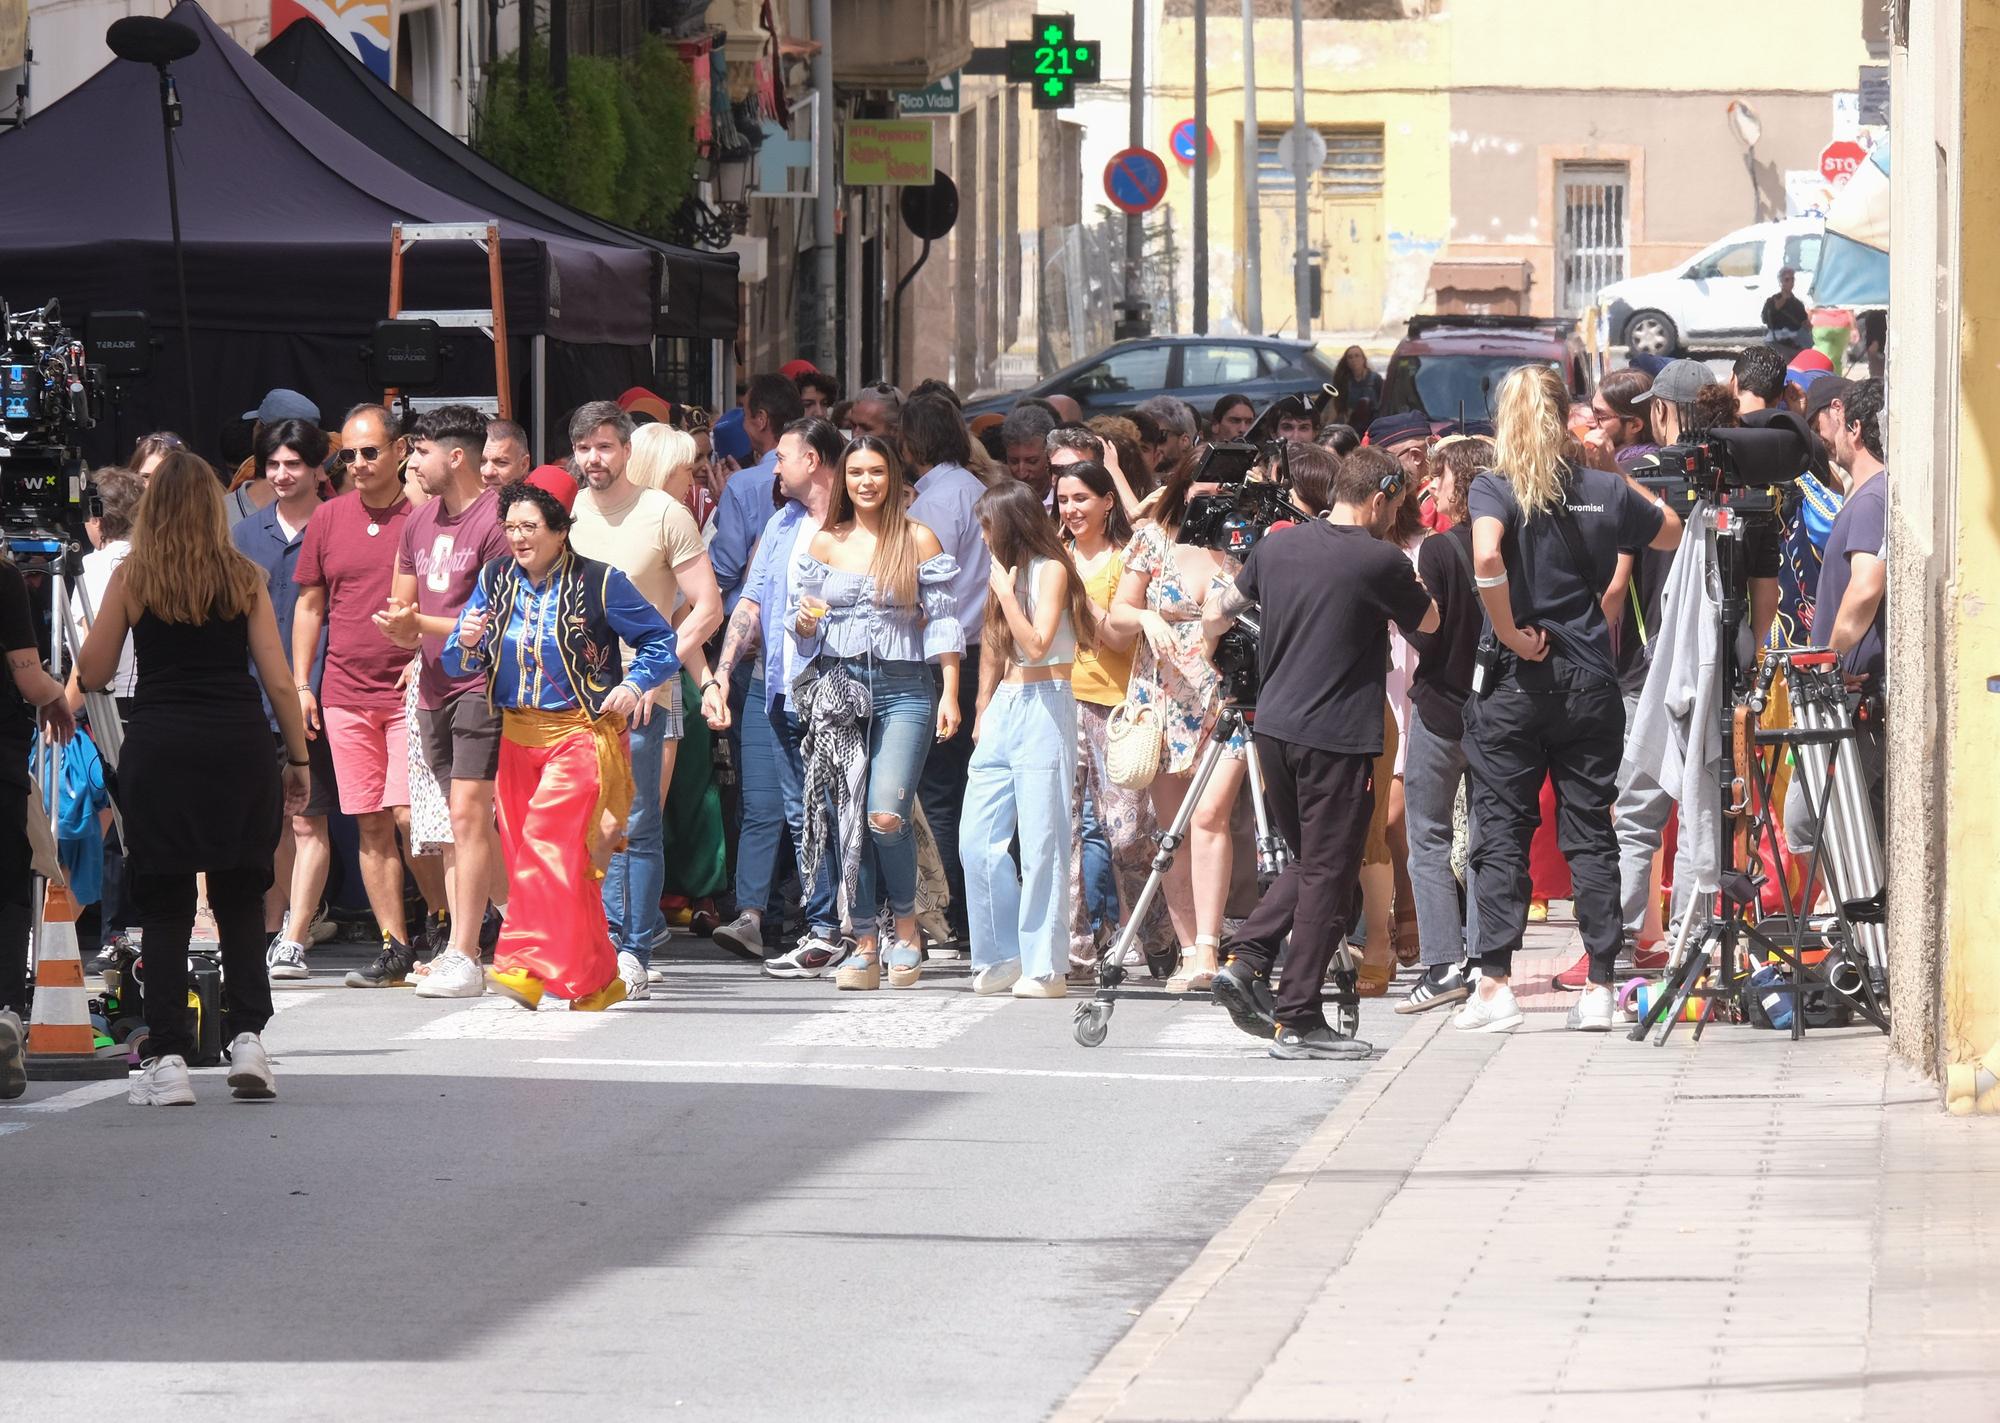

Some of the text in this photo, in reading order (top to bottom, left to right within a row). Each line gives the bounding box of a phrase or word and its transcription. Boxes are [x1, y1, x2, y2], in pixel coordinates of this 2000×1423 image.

[898, 93, 954, 108] Rico Vidal
[1824, 157, 1858, 172] STO
[96, 340, 136, 349] TERADEK
